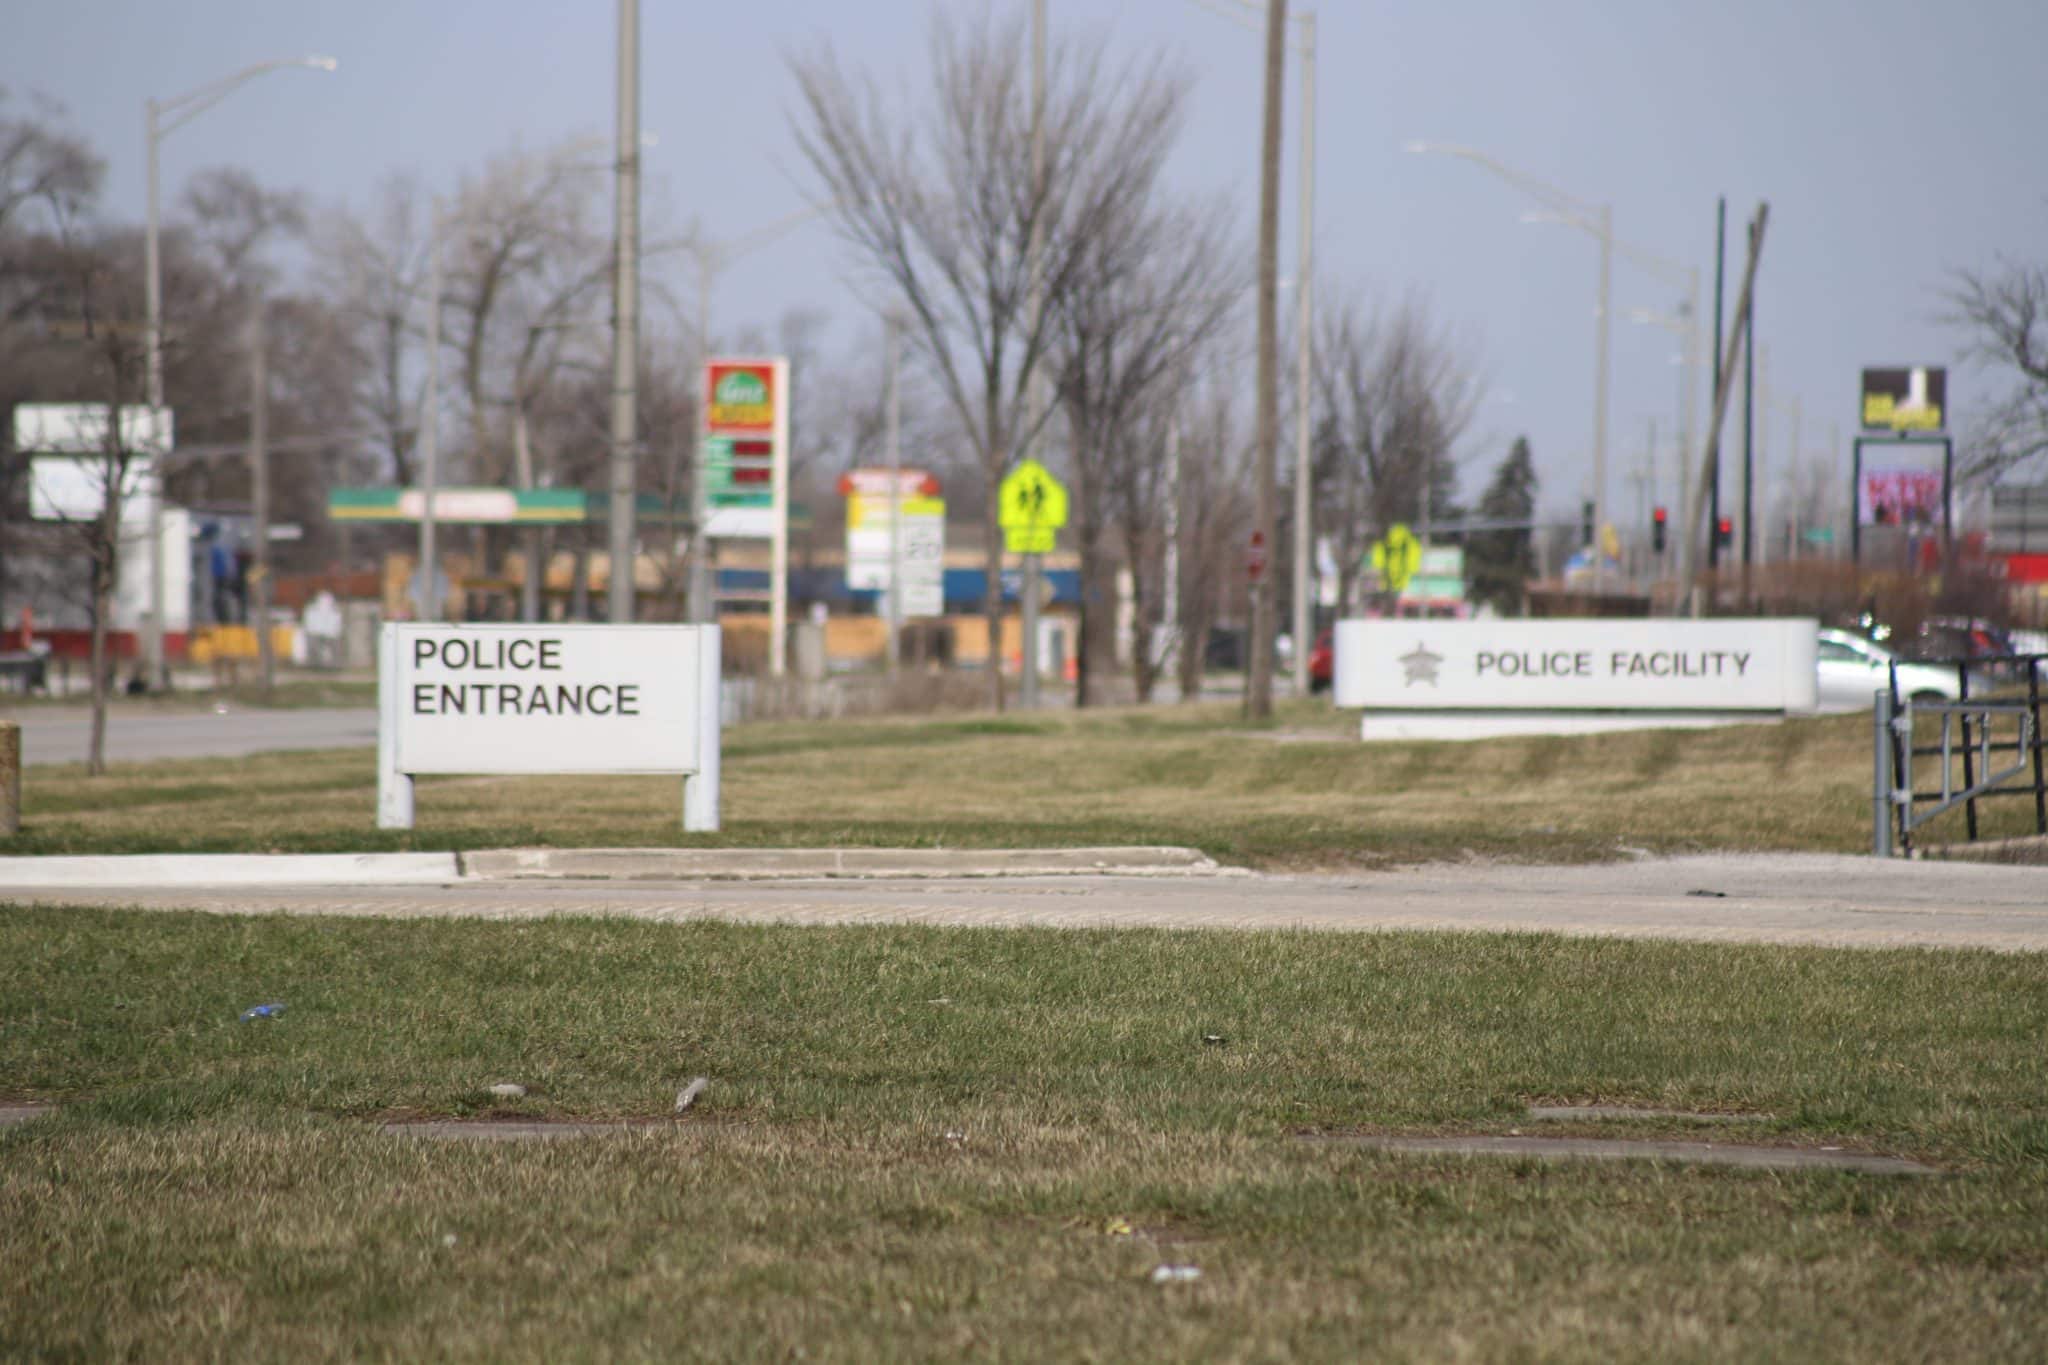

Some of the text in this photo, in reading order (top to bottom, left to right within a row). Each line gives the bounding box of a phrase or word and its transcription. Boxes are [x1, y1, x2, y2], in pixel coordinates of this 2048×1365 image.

[414, 639, 561, 670] POLICE
[1476, 651, 1751, 677] POLICE FACILITY
[413, 684, 638, 715] ENTRANCE
